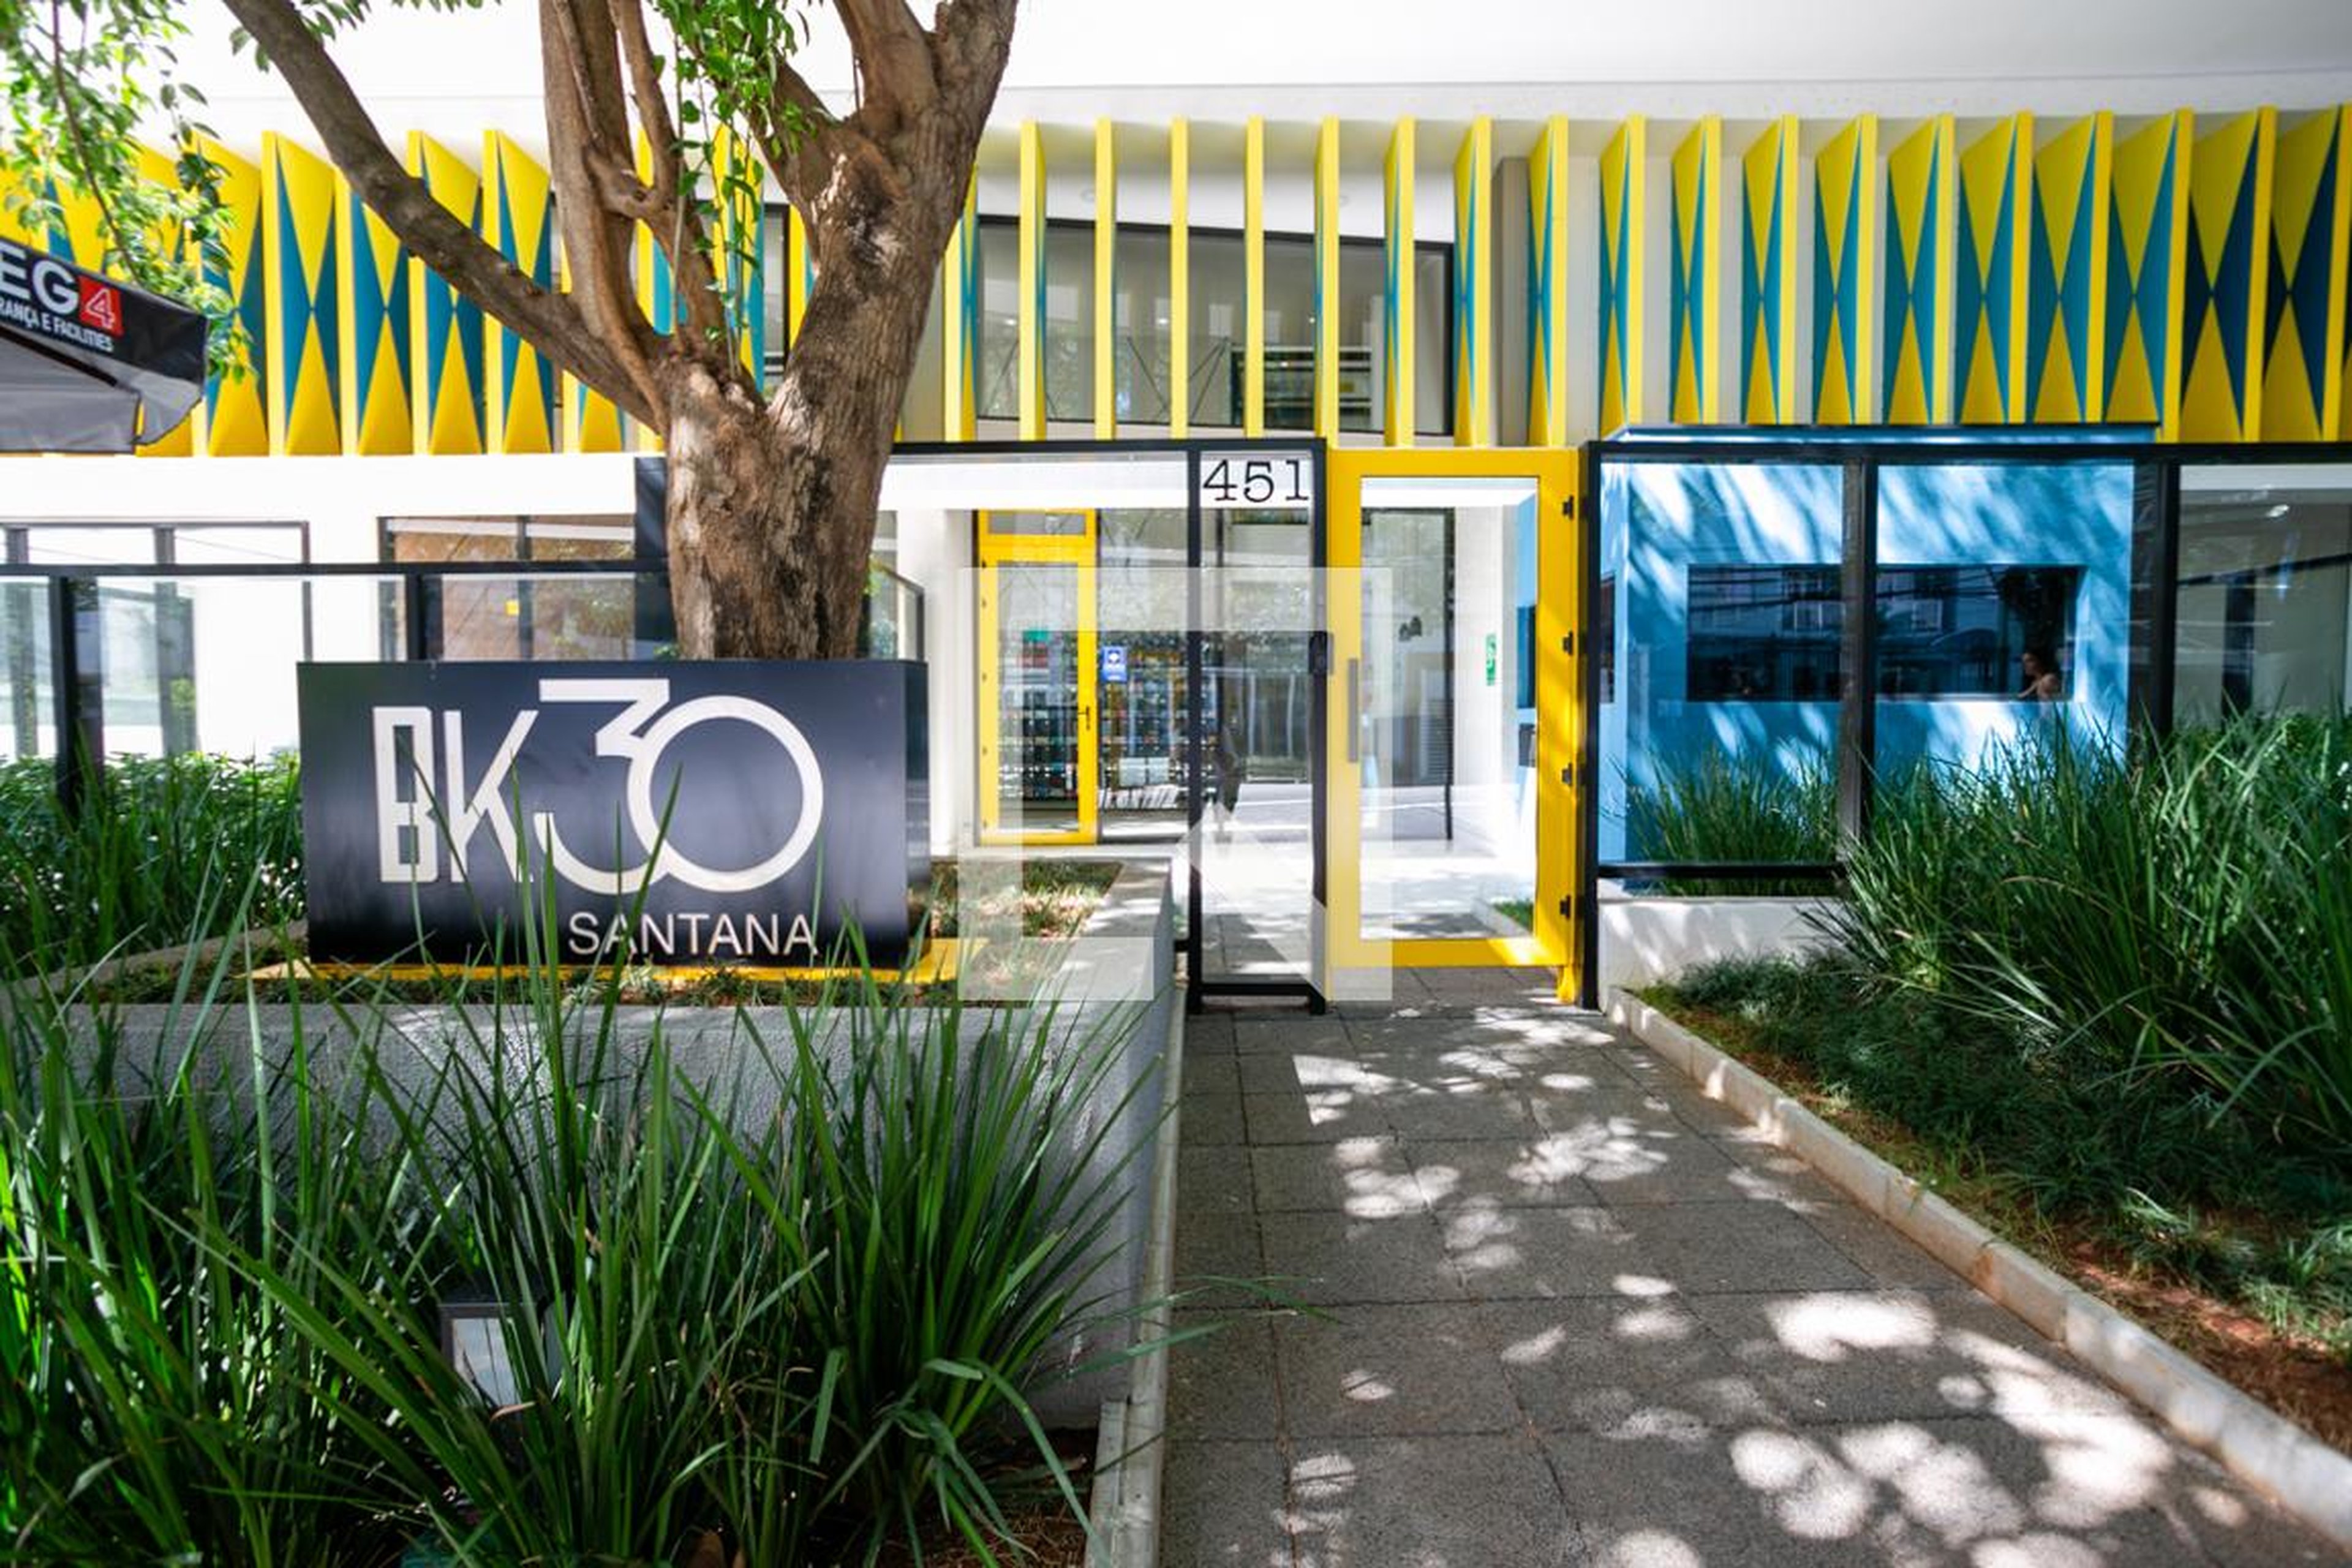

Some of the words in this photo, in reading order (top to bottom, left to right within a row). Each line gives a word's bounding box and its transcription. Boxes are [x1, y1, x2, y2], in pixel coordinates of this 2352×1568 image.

[42, 313, 51, 331] E
[1202, 459, 1309, 503] 451
[568, 911, 818, 956] SANTANA
